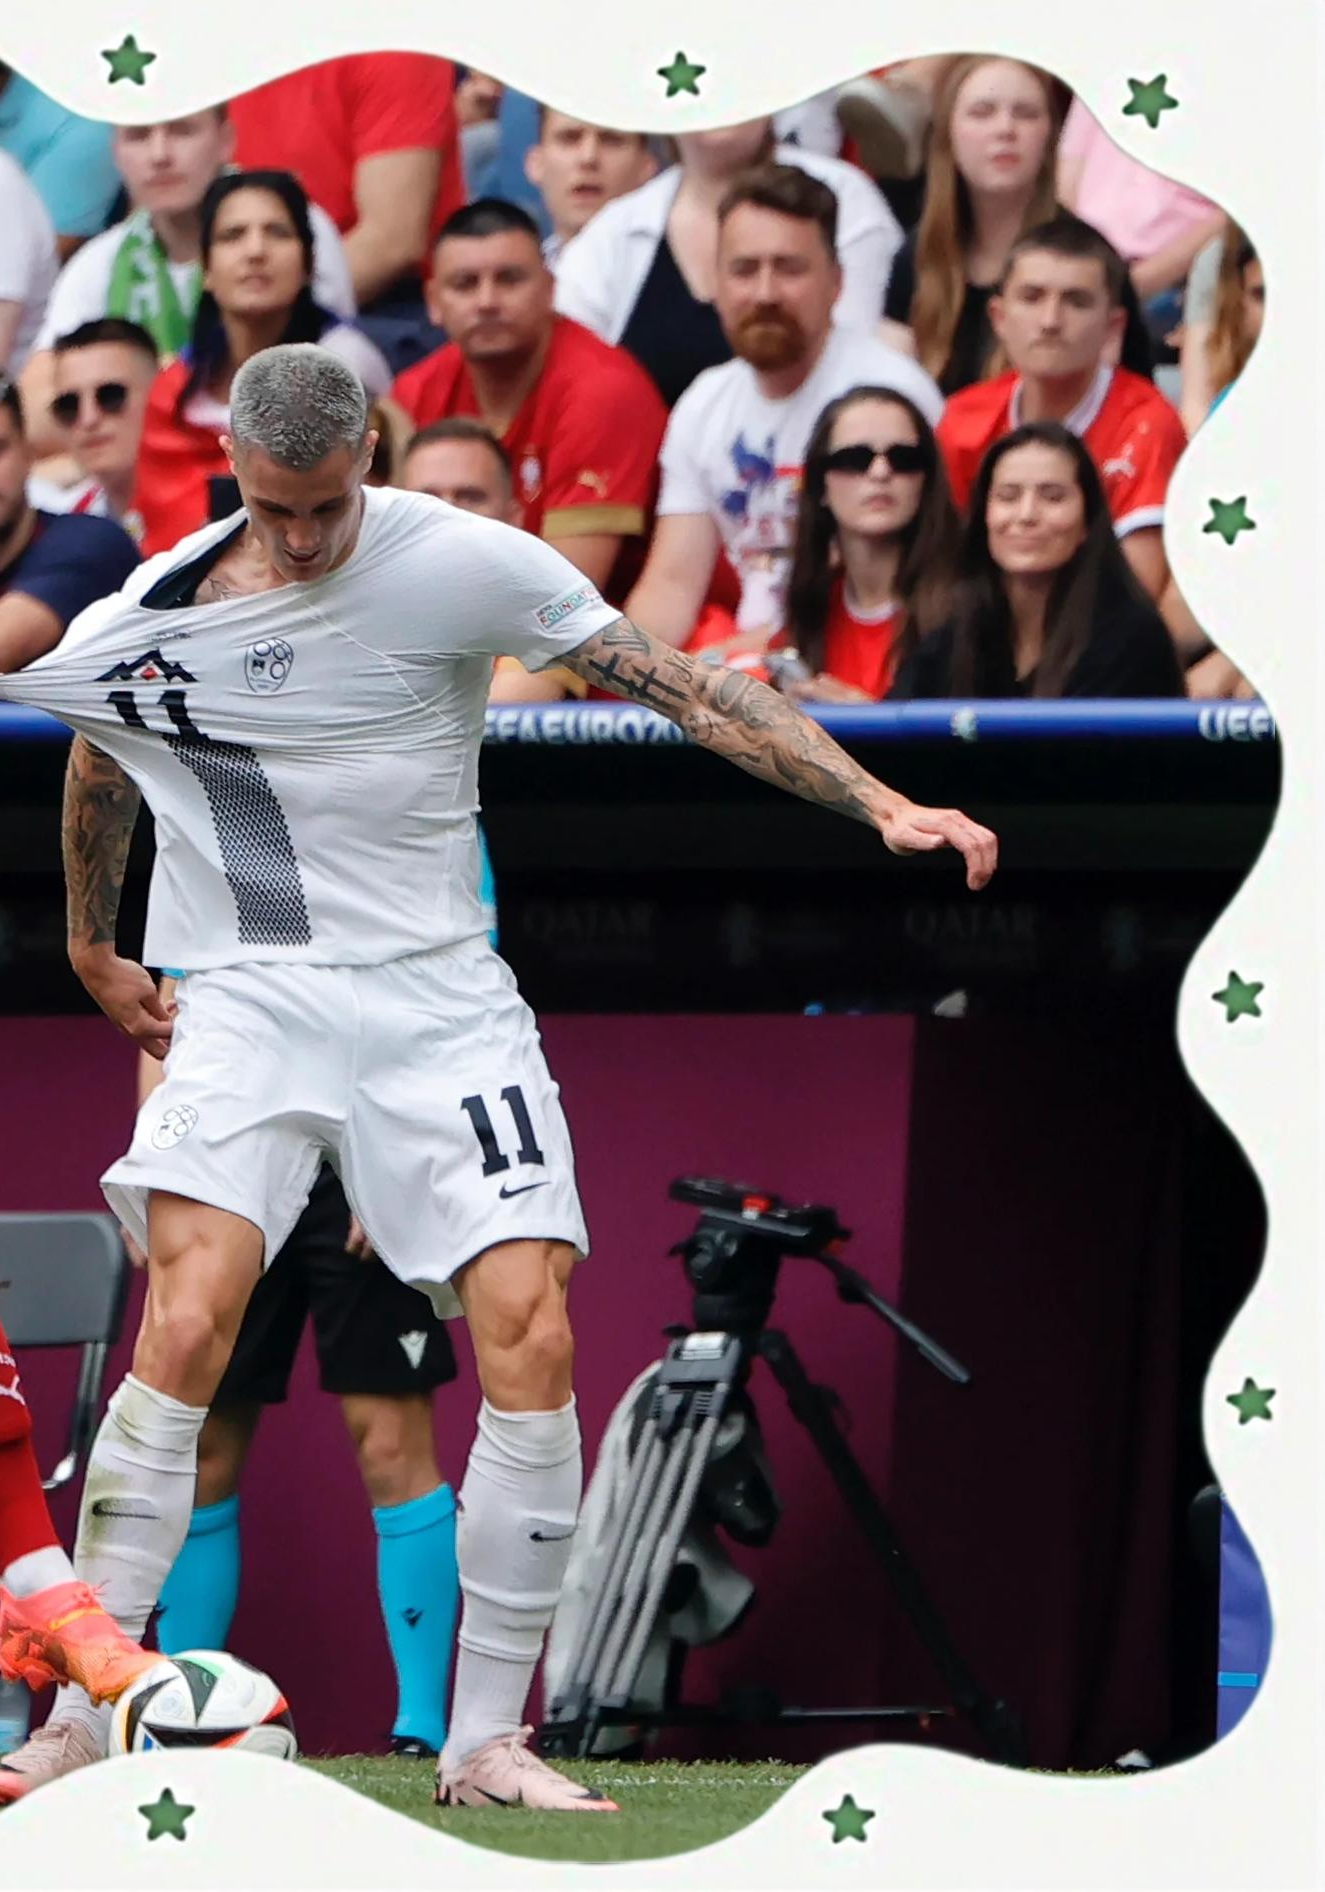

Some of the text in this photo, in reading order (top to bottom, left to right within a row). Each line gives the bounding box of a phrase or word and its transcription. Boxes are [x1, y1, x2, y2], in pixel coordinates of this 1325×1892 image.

[106, 690, 211, 742] 11
[1198, 706, 1275, 742] UEF
[460, 1085, 545, 1178] 11
